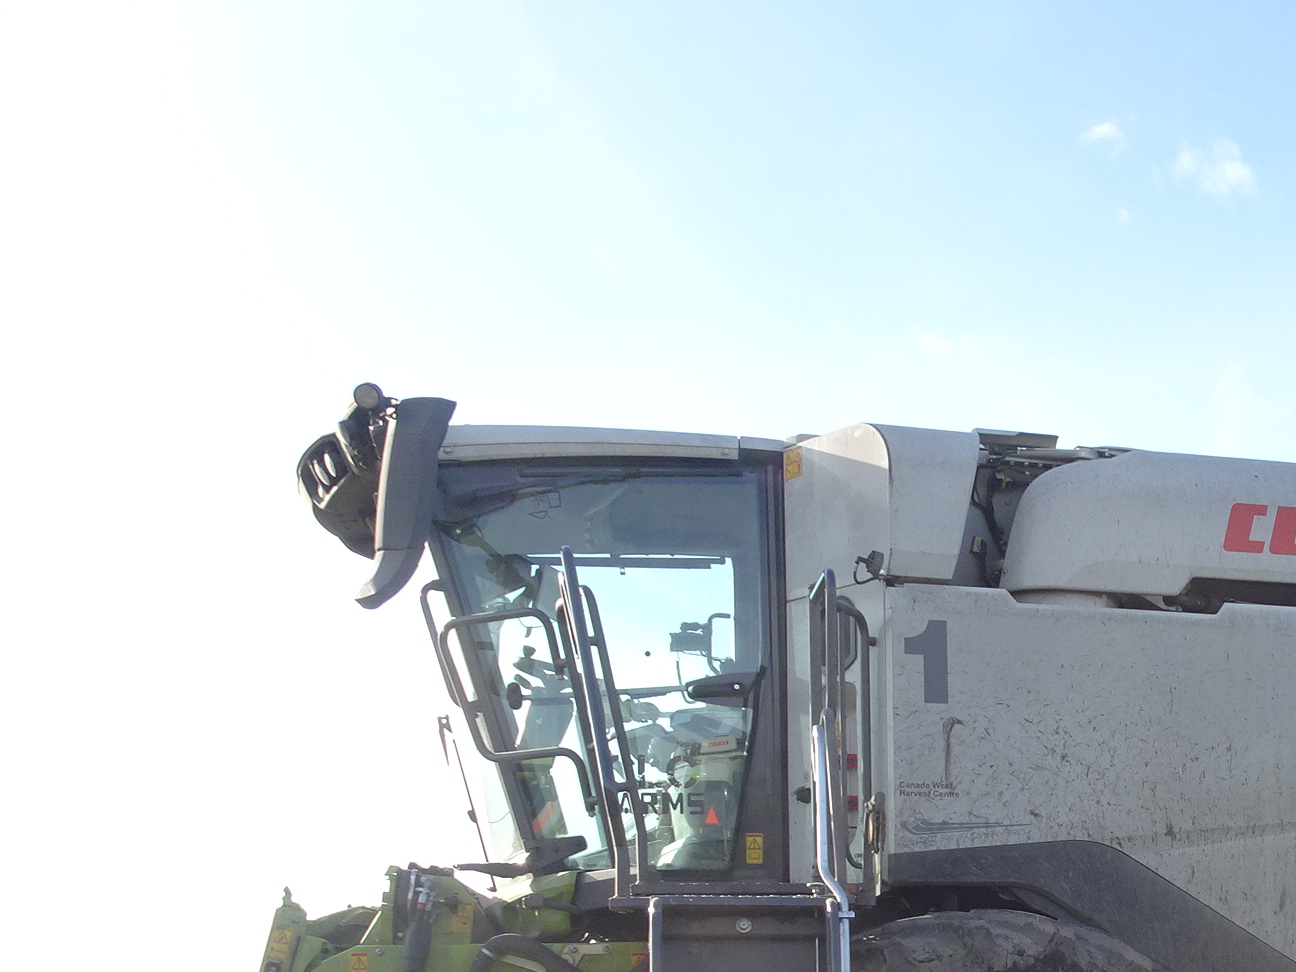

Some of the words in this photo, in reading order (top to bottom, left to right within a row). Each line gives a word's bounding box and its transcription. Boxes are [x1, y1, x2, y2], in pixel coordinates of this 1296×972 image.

[903, 619, 949, 704] 1
[899, 781, 930, 789] Canada
[932, 781, 953, 790] West
[899, 790, 931, 798] Harvest
[933, 790, 960, 798] Centre
[615, 792, 705, 815] ARMS
